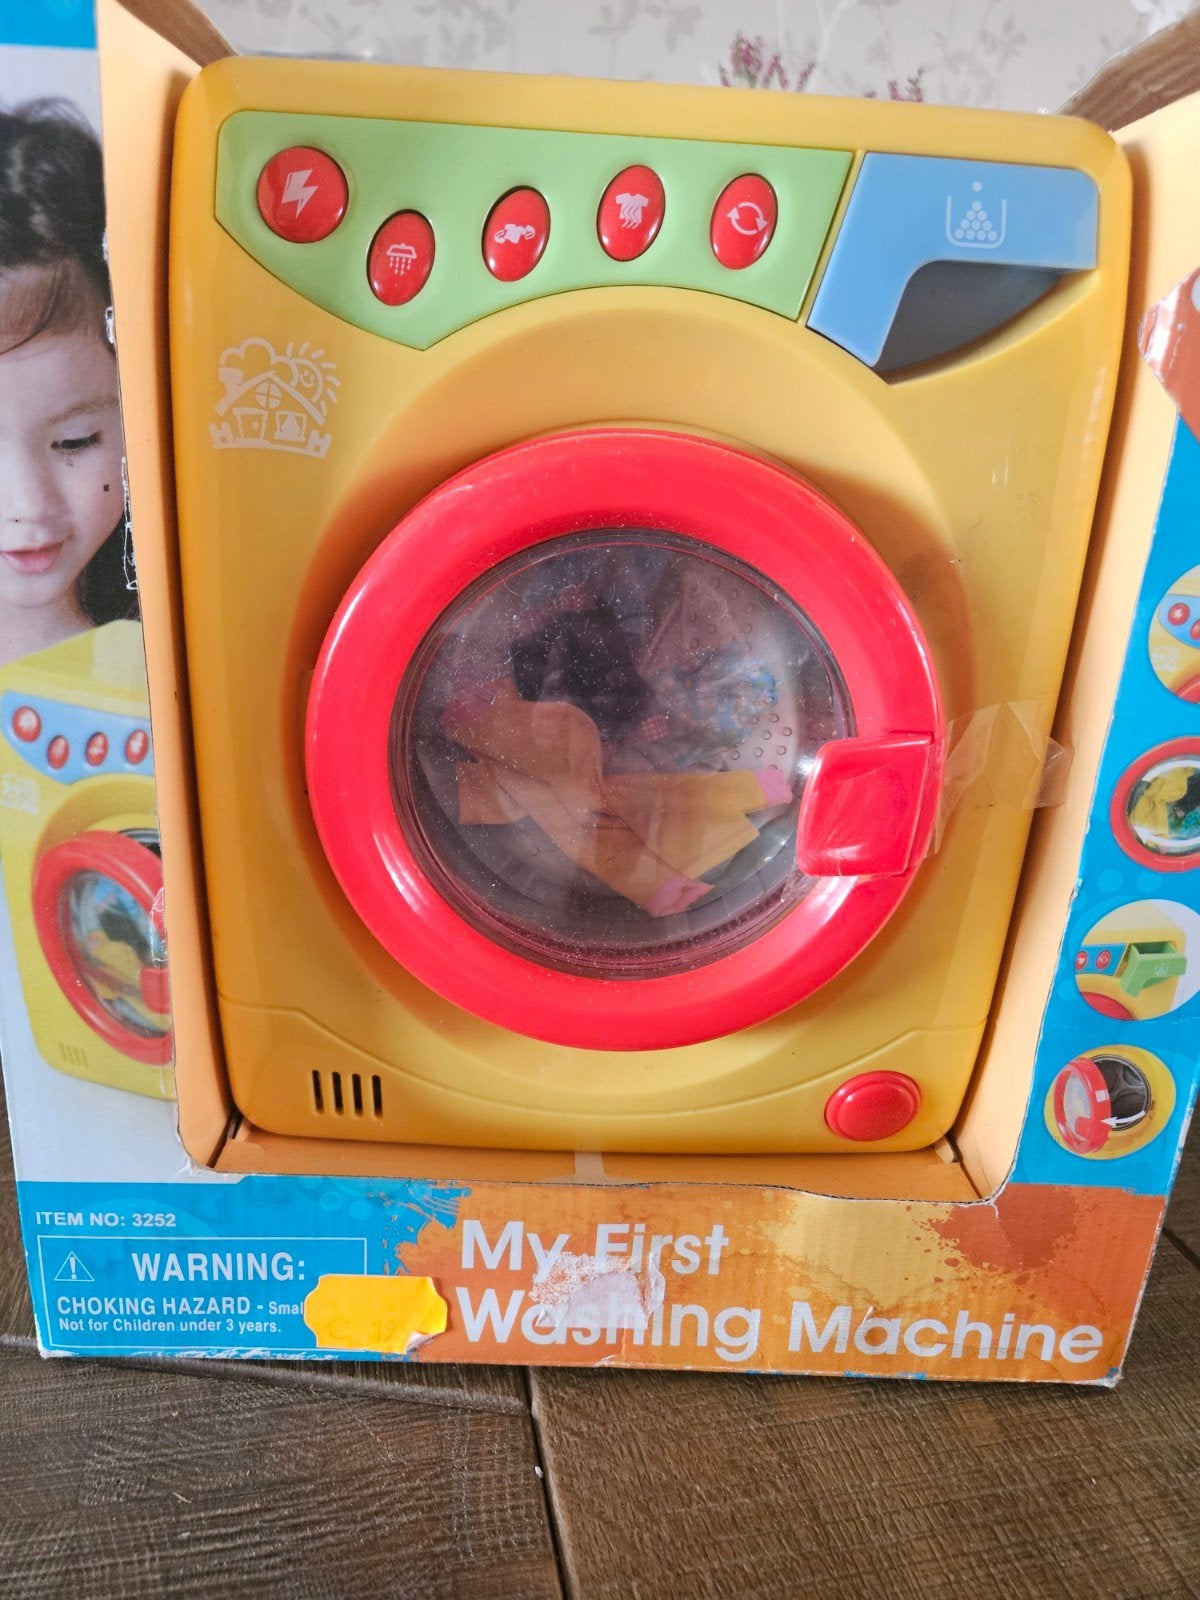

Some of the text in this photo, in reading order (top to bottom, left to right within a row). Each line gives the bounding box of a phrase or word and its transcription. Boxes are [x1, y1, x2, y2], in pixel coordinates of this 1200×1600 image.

[36, 1211, 176, 1227] ITEM NO: 3252
[461, 1219, 729, 1284] My First
[131, 1251, 305, 1281] WARNING:
[57, 1296, 155, 1315] CHOKING
[162, 1296, 251, 1315] HAZARD
[268, 1301, 304, 1315] Smal
[58, 1318, 282, 1334] Not for Children under 3 years.
[456, 1286, 1103, 1363] Washing Machine
